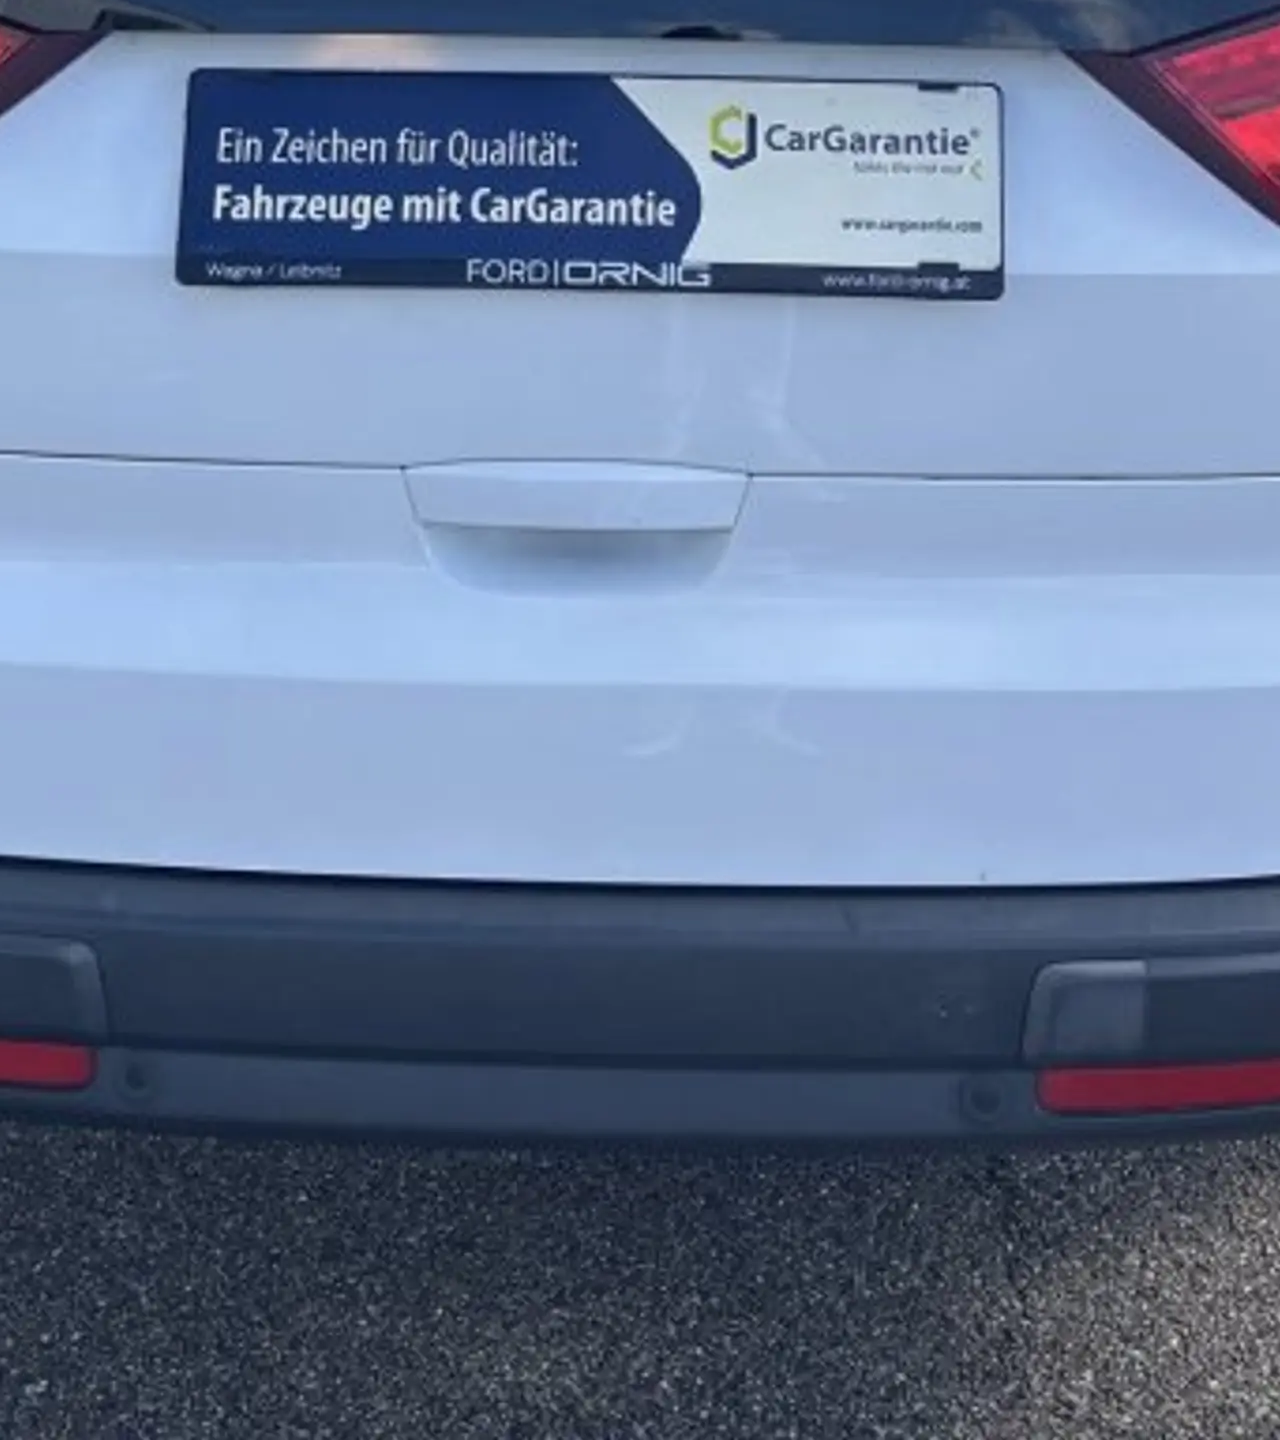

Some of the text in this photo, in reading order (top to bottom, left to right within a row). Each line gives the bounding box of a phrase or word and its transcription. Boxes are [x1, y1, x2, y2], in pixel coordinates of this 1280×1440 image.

[217, 126, 579, 170] Ein Zeichen für Qualität:
[213, 184, 677, 231] Fahrzeuge mit CarGarantie
[466, 258, 712, 287] FORD ORNIG
